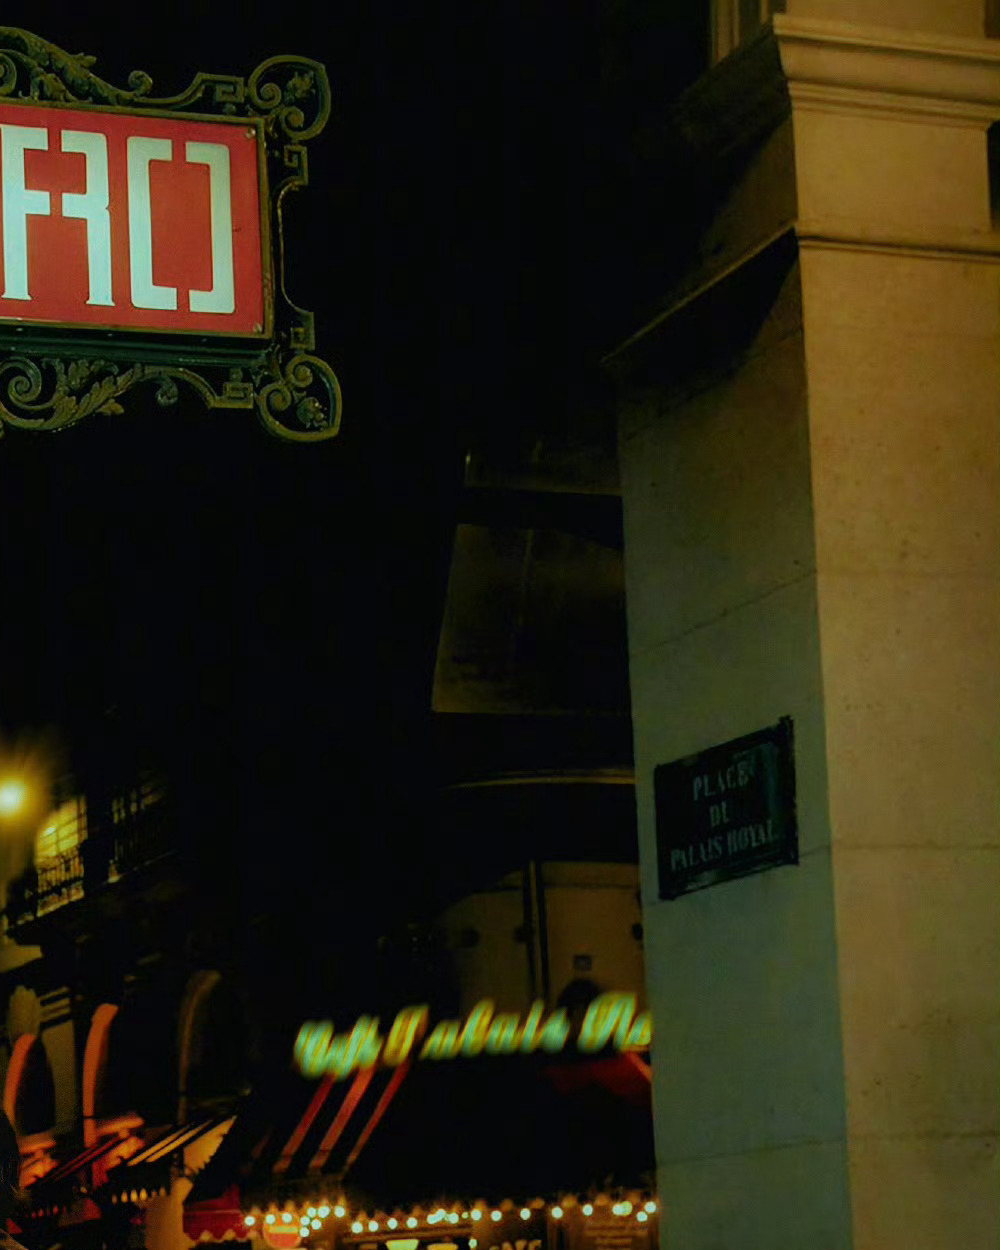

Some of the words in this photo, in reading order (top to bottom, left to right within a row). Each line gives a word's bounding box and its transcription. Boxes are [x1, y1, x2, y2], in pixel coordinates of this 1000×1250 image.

[692, 760, 751, 801] PLACE
[669, 835, 723, 871] PALAIS
[726, 819, 776, 855] ROYAL
